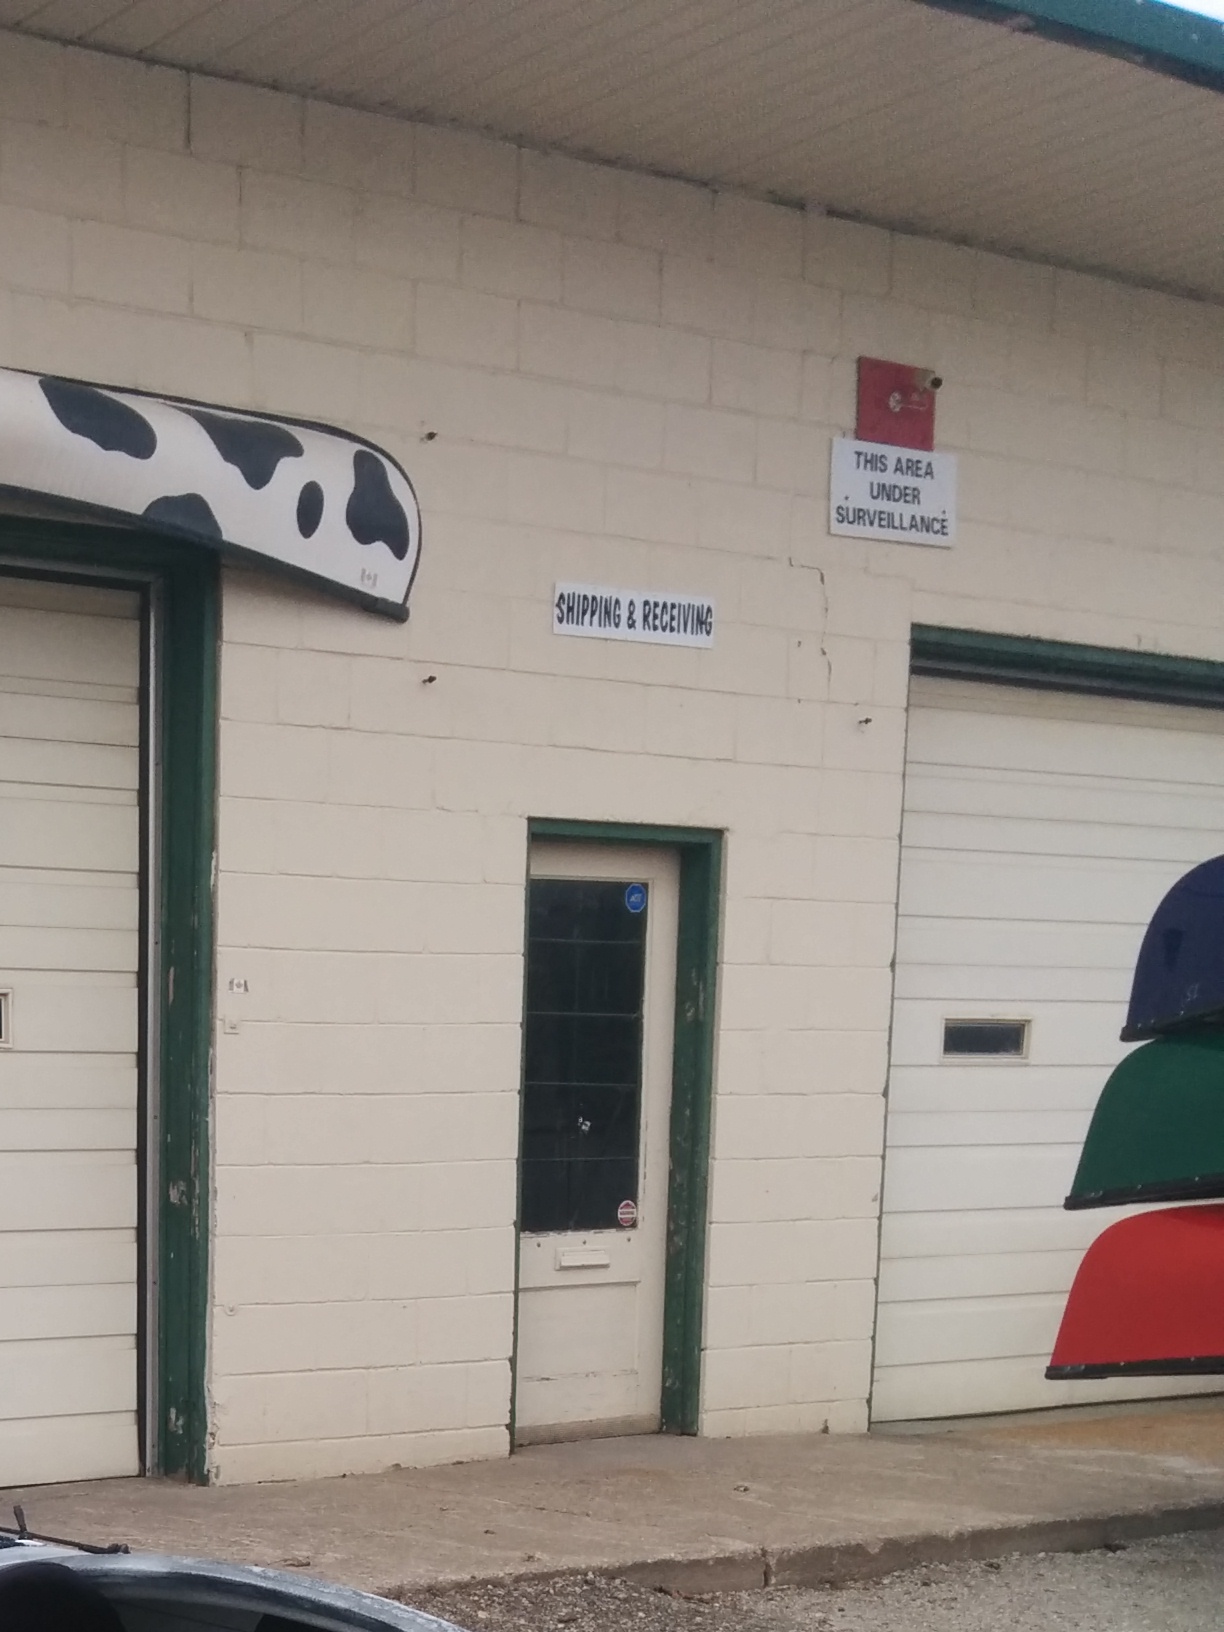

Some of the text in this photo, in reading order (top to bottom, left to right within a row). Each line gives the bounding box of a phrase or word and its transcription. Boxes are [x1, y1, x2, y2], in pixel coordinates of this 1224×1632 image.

[854, 451, 934, 479] THIS AREA
[869, 481, 921, 505] UNDER
[836, 504, 949, 536] SURVEILLANCE
[555, 591, 713, 636] SHIPPING & RECEIVING
